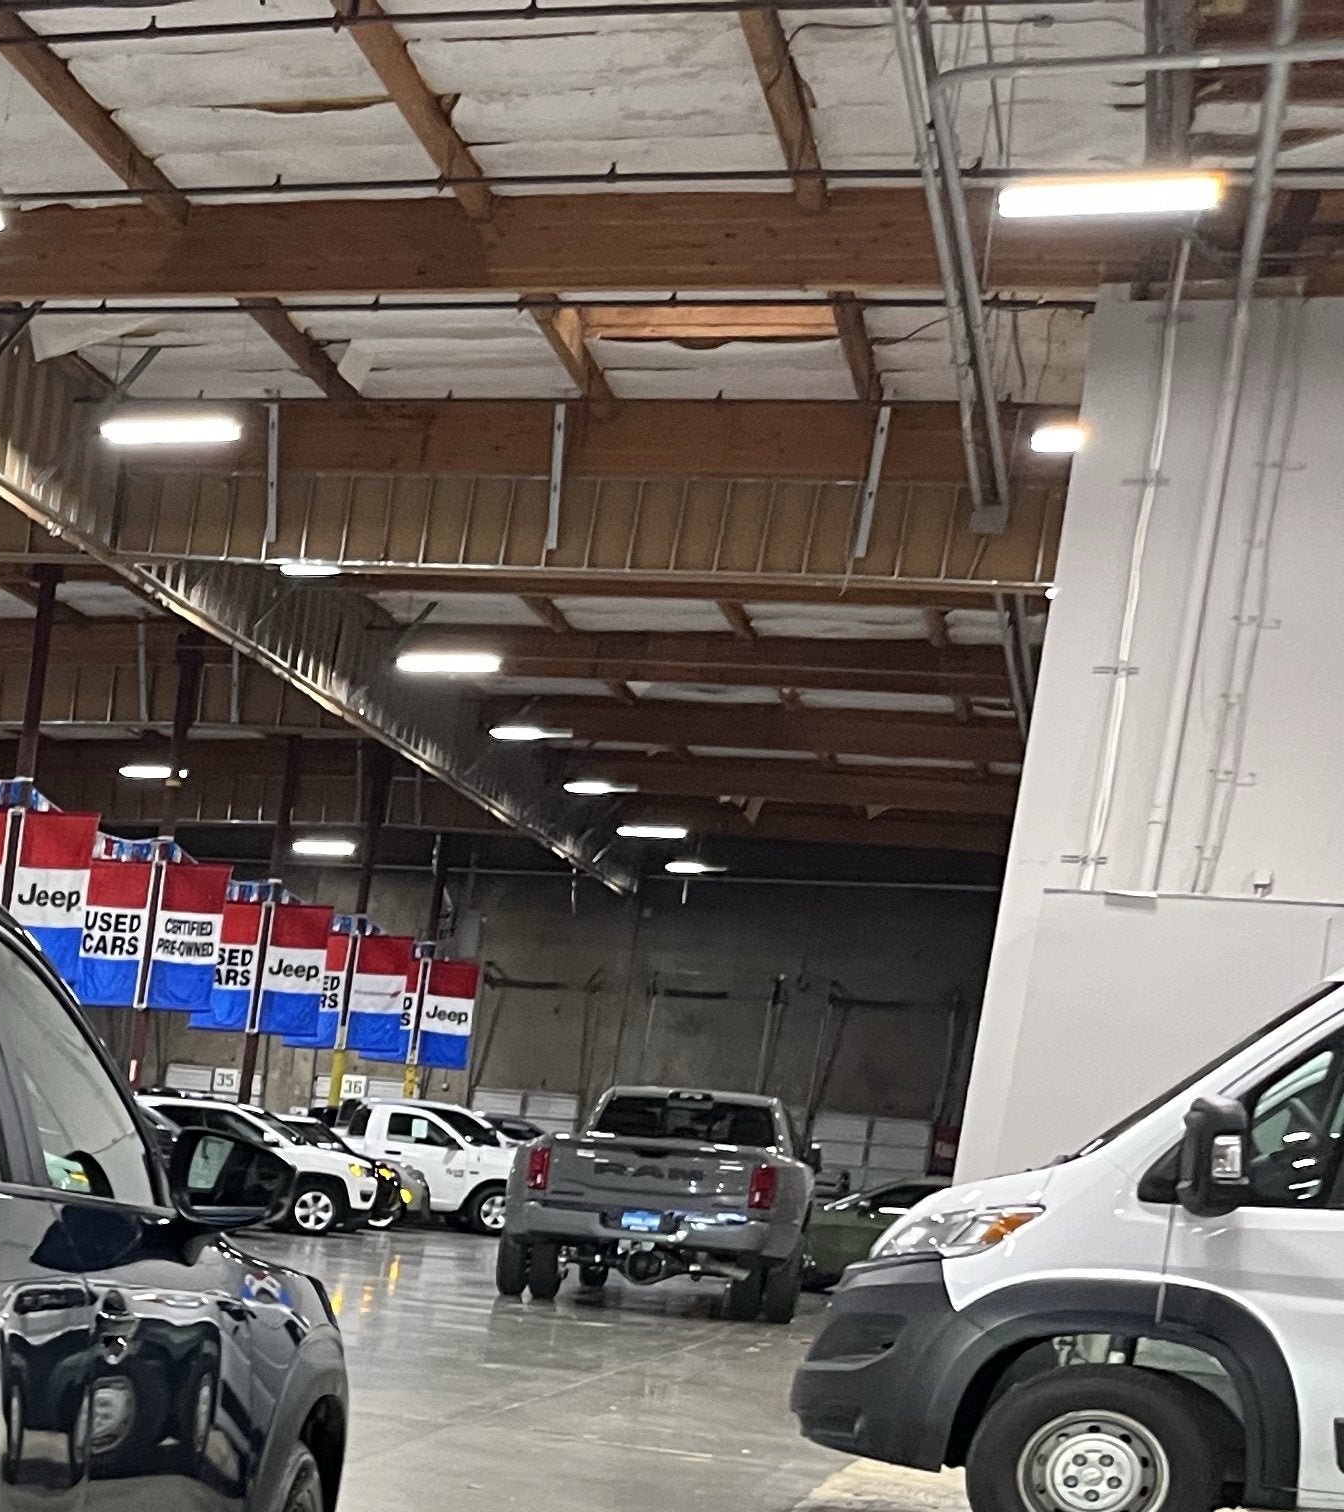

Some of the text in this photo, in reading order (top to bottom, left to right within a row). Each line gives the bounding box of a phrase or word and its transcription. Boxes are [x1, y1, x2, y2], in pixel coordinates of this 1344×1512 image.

[18, 883, 80, 912] Jeep
[85, 911, 141, 933] USED
[164, 918, 213, 937] CERTIFIED
[82, 933, 139, 955] CARS
[156, 938, 214, 957] PRE-OWNED
[216, 948, 254, 966] SED
[214, 968, 251, 986] ARS
[268, 958, 320, 982] Jeep
[425, 1005, 468, 1025] Jeep
[216, 1072, 234, 1087] 35
[344, 1079, 362, 1094] 36
[594, 1162, 704, 1181] RAM
